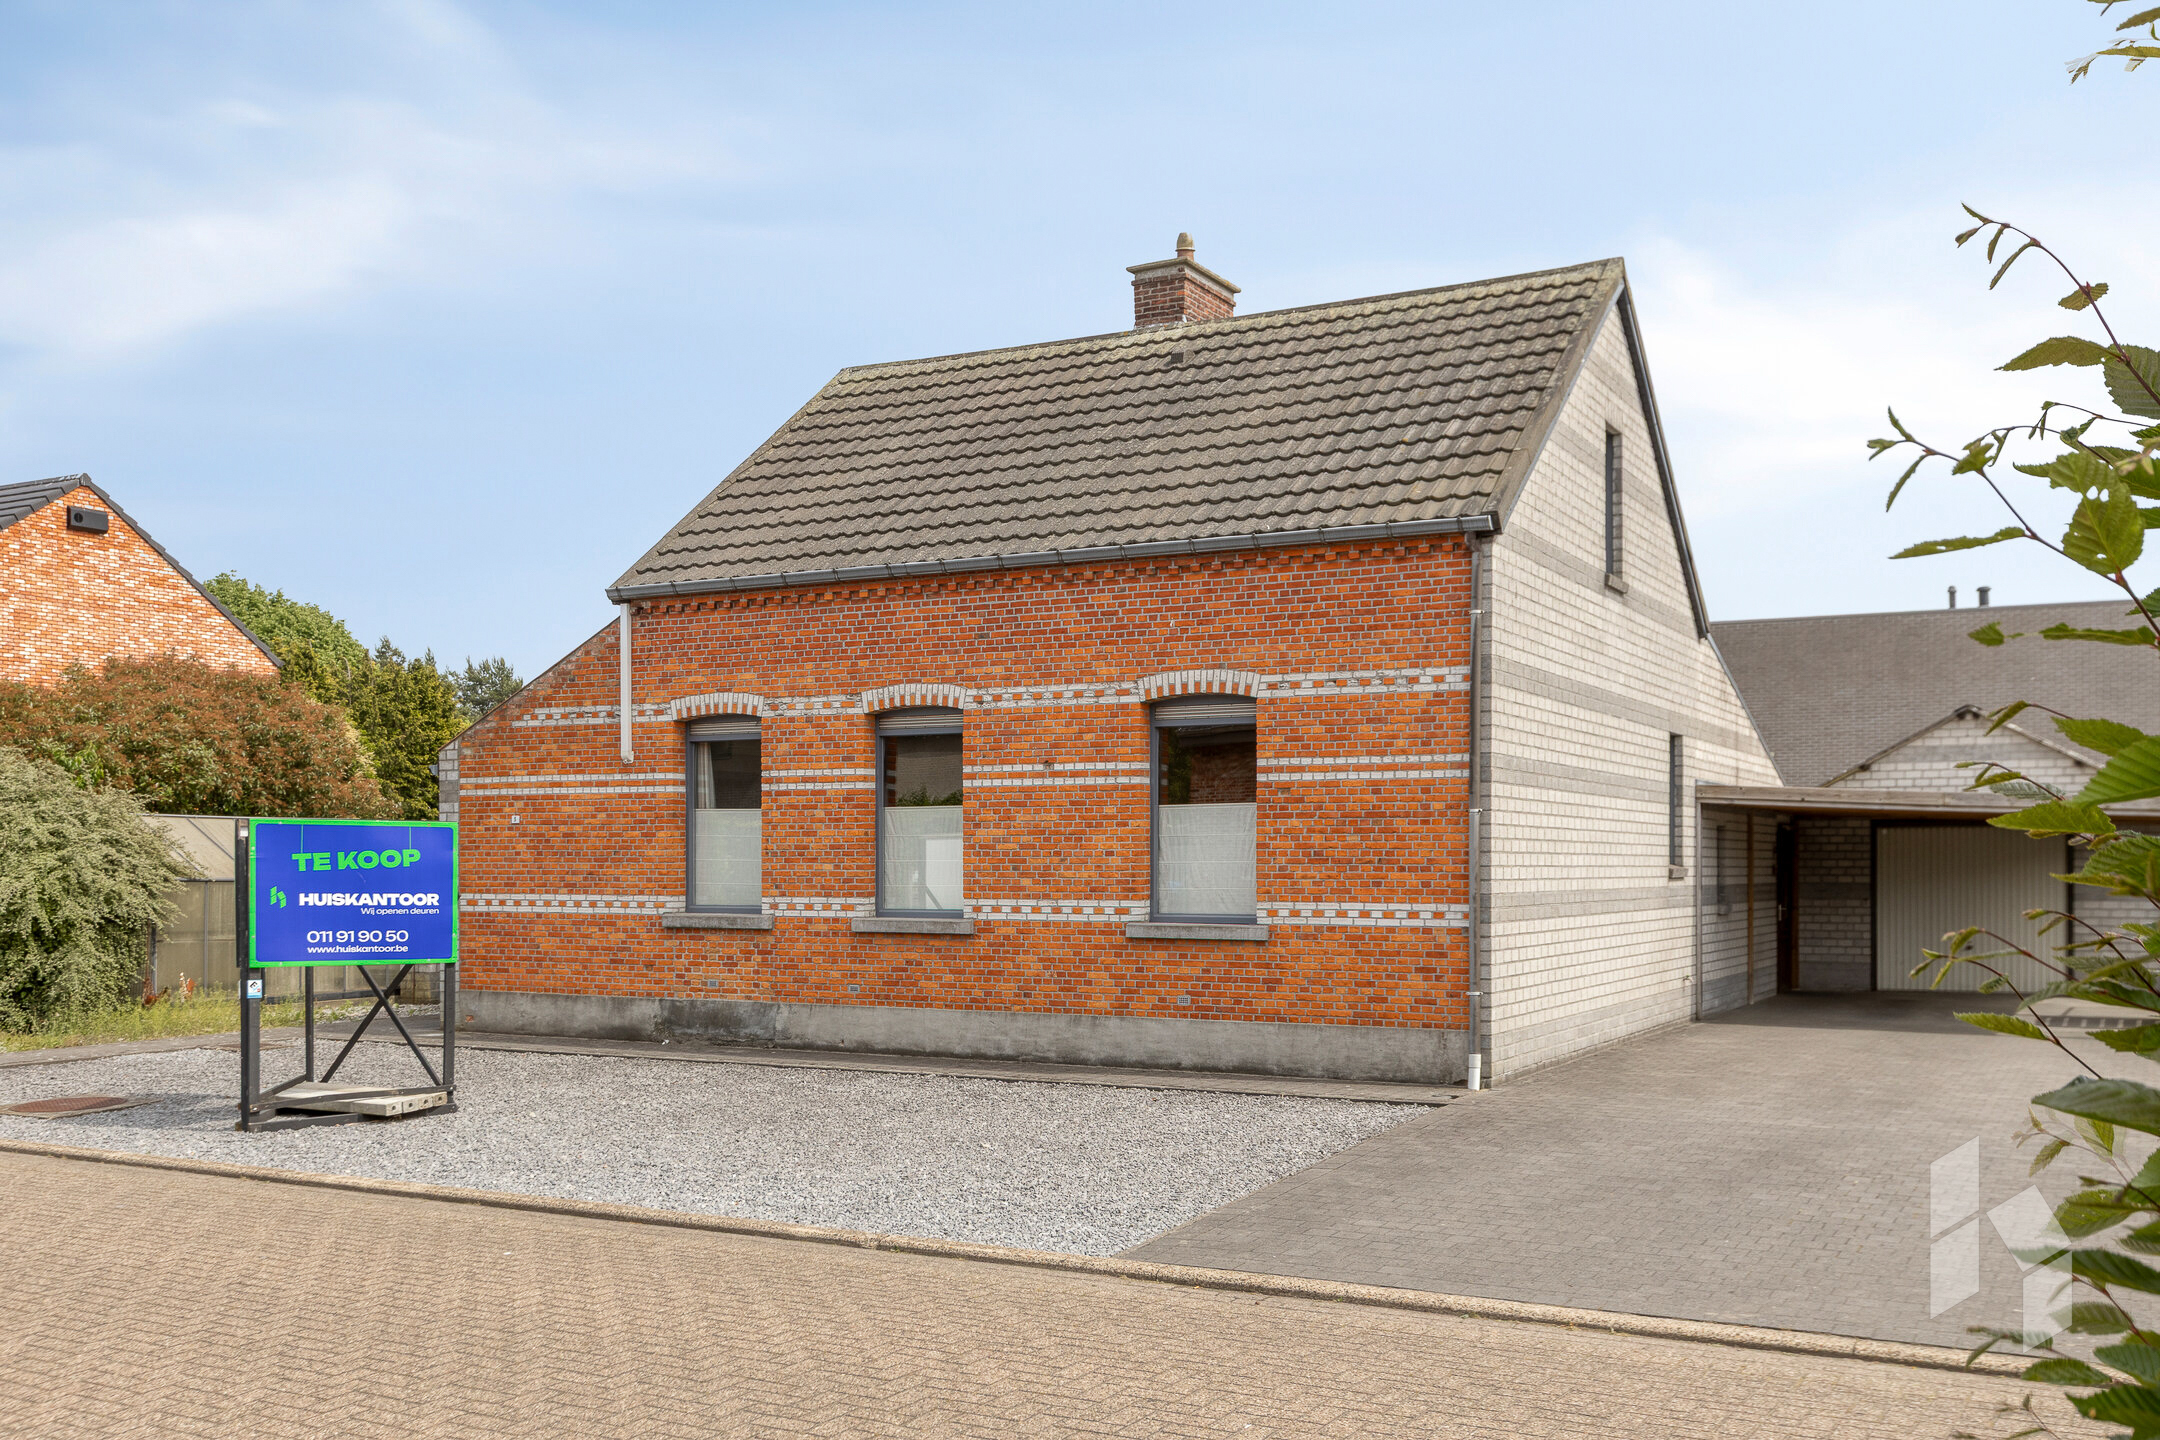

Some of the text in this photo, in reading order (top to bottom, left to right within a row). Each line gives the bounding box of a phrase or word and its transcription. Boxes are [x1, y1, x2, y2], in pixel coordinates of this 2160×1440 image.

[291, 848, 421, 872] TE KOOP
[298, 893, 440, 906] HUISKANTOOR
[360, 907, 375, 916] Wij
[410, 907, 440, 915] deuren
[306, 930, 409, 943] 011 91 90 50
[307, 944, 409, 953] www.huiskantoor.be
